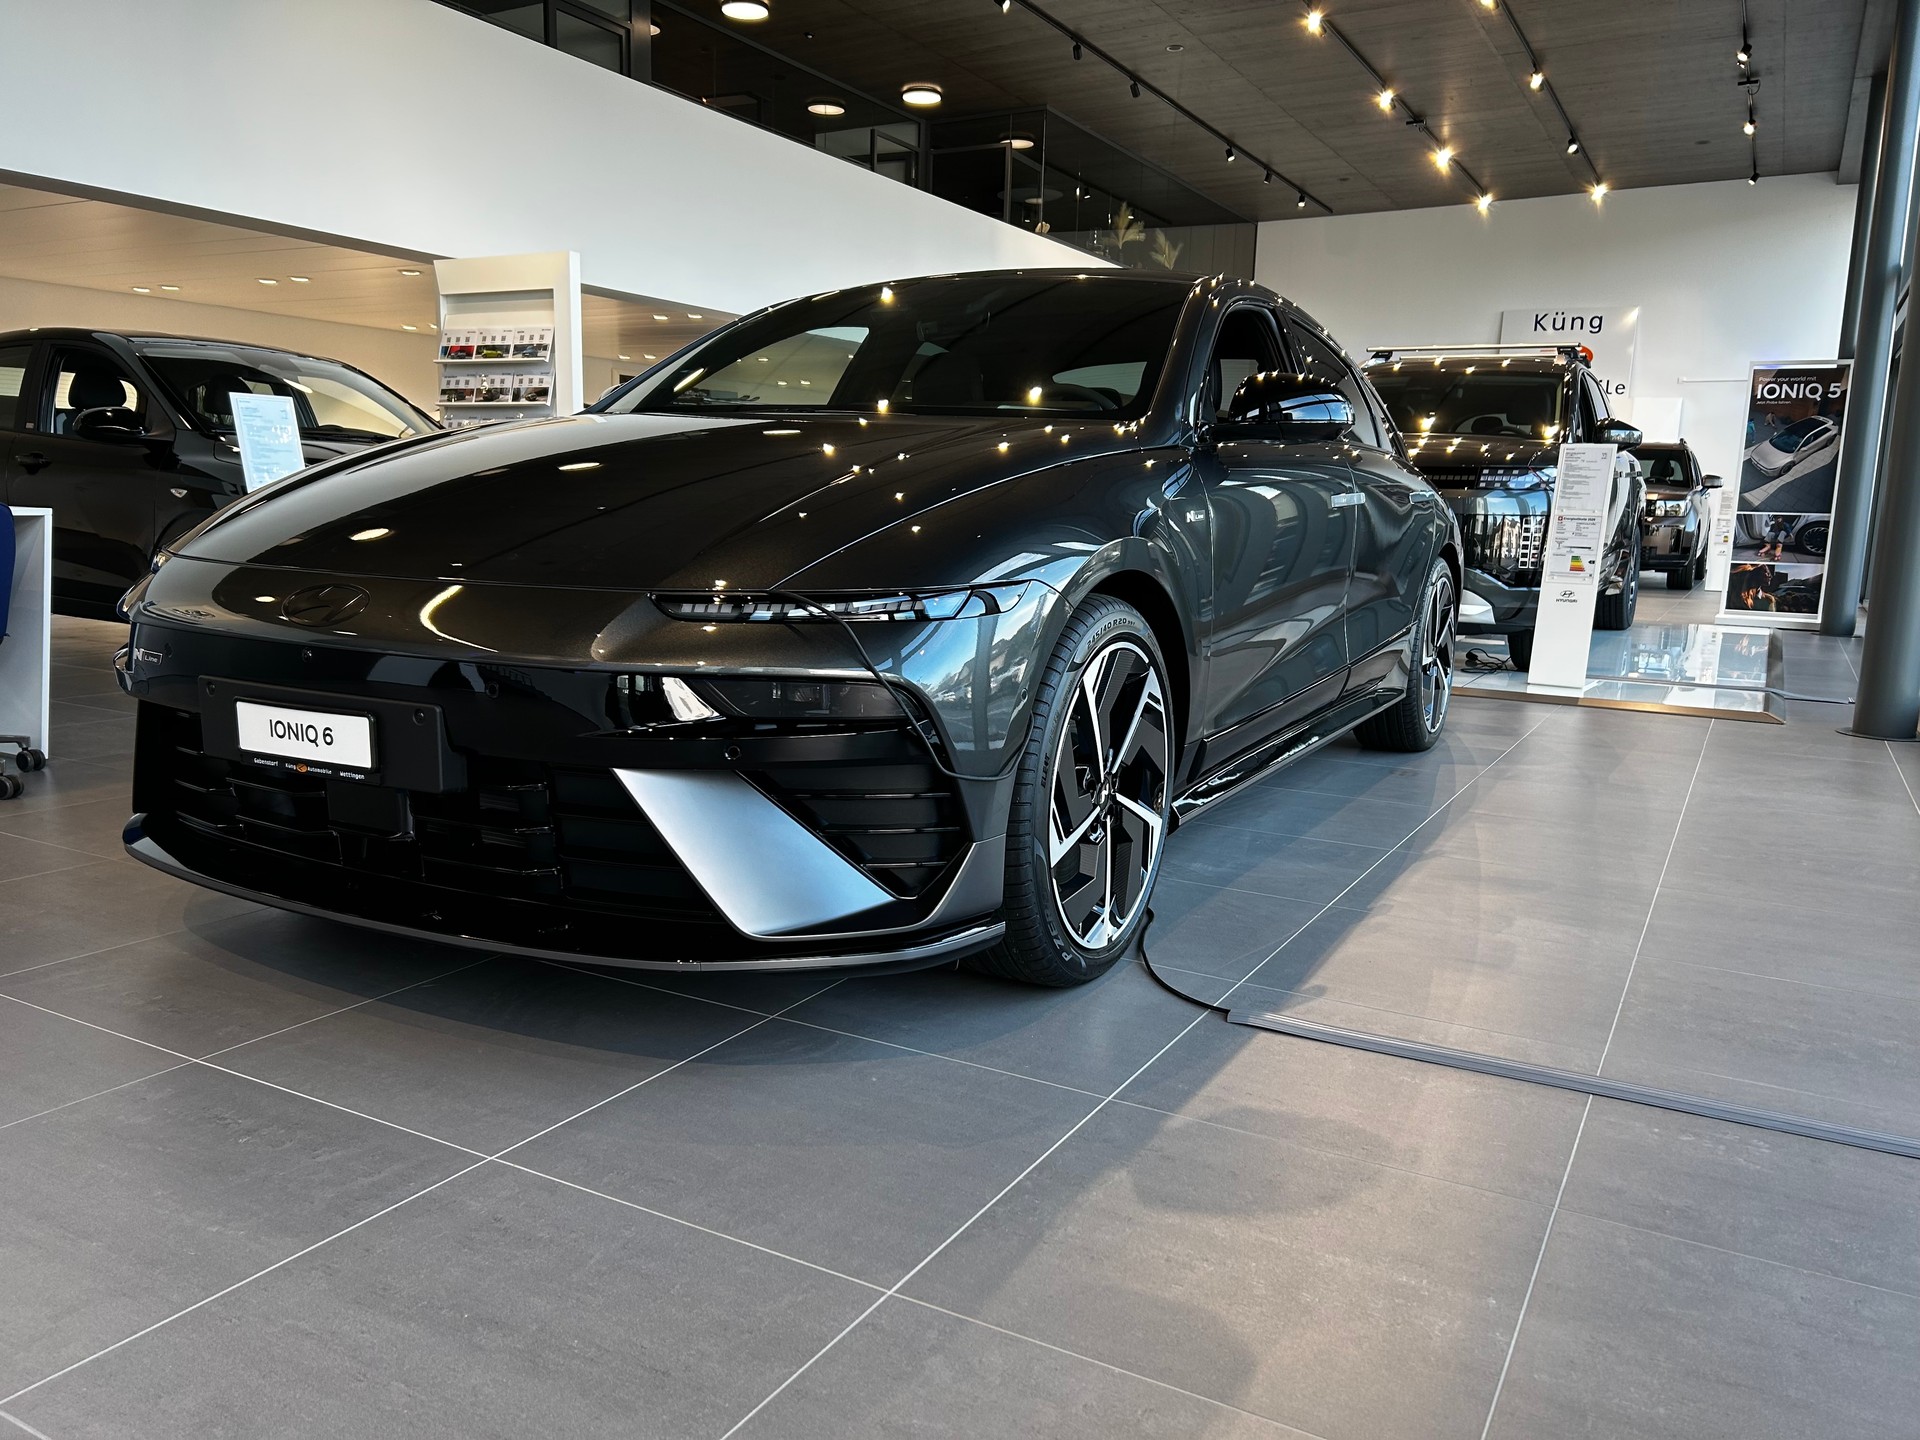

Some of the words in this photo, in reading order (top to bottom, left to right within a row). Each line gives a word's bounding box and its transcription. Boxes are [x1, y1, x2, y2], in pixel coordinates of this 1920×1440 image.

[1534, 311, 1604, 334] Küng
[1757, 383, 1823, 401] IONIQ
[1827, 383, 1841, 399] 5
[1186, 510, 1195, 522] N
[269, 719, 319, 747] IONIQ
[322, 727, 334, 746] 6
